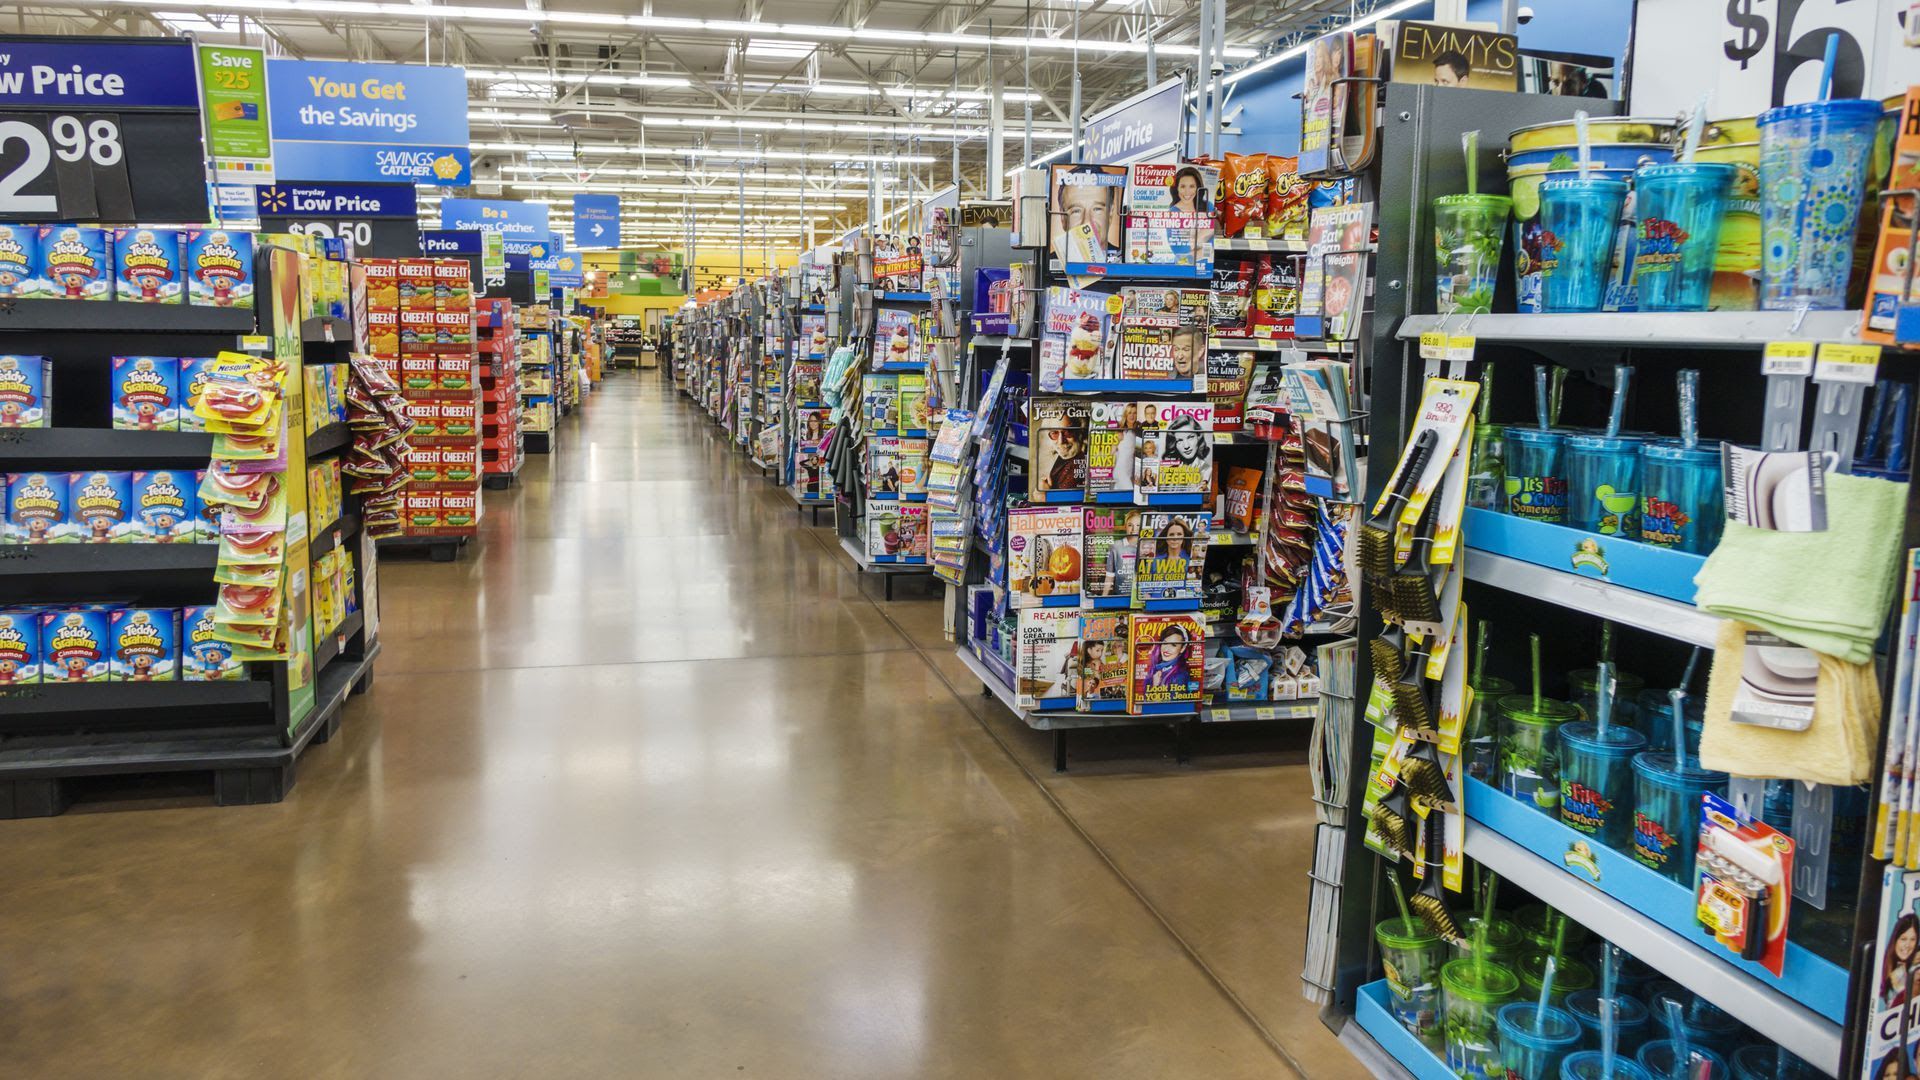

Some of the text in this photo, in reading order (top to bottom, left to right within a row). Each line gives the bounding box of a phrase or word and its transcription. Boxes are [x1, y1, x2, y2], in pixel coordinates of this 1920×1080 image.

[1402, 26, 1515, 69] EMMYS
[211, 52, 253, 69] Save
[31, 64, 125, 96] Price
[308, 76, 406, 101] You Get
[299, 105, 418, 132] the Savings
[1100, 120, 1153, 160] Low Price
[376, 151, 436, 167] SAVINGS
[380, 165, 432, 177] CATCHER
[1135, 165, 1177, 177] Woman's
[1055, 168, 1124, 189] People TRIBUTE
[1135, 176, 1164, 186] World
[292, 188, 326, 198] Everyday
[293, 196, 381, 211] Low Price
[483, 207, 508, 218] Be a
[1311, 209, 1364, 229] Prevention
[456, 220, 535, 233] Savings Catcher.
[1321, 231, 1338, 242] Eat
[53, 241, 90, 256] Teddy
[129, 243, 164, 258] Teddy
[202, 244, 238, 259] Teddy
[428, 240, 459, 251] Price
[48, 251, 96, 267] Grahams
[124, 254, 169, 269] Grahams
[197, 255, 243, 270] Grahams
[1328, 255, 1354, 268] Weight
[399, 264, 432, 277] CHEEZ-IT
[434, 266, 468, 278] CHEEZ-IT
[401, 312, 434, 324] CHEEZ-IT
[436, 313, 469, 325] CHEEZ-IT
[1049, 307, 1077, 322] Save
[1124, 317, 1178, 326] GLOBE
[1123, 345, 1172, 357] AUTOPSY
[402, 359, 436, 371] CHEEZ-IT
[438, 359, 471, 371] CHEEZ-IT
[1123, 358, 1174, 371] SHOCKER!
[1220, 367, 1245, 376] LINK'S
[128, 369, 163, 384] Teddy
[122, 380, 168, 395] Grahams
[406, 405, 440, 417] CHEEZ-IT
[441, 405, 475, 417] CHEEZ-IT
[1033, 406, 1066, 421] Jerry
[1161, 407, 1212, 422] closer
[407, 451, 440, 463] CHEEZ-IT
[442, 451, 474, 463] CHEEZ-IT
[1159, 473, 1201, 485] LEGEND
[1523, 476, 1543, 493] It's
[20, 487, 54, 502] Teddy
[83, 486, 118, 500] Teddy
[146, 485, 180, 499] Teddy
[14, 497, 59, 511] Grahams
[77, 496, 122, 510] Grahams
[140, 494, 185, 508] Grahams
[407, 496, 440, 508] CHEEZ-IT
[442, 496, 475, 508] CHEEZ-IT
[1008, 514, 1082, 532] Halloween
[1086, 510, 1115, 529] Good
[1142, 514, 1168, 529] Life
[1139, 559, 1186, 574] AT WAR
[1034, 612, 1057, 620] REAL
[57, 626, 92, 640] Teddy
[124, 624, 157, 638] Teddy
[52, 635, 98, 650] Grahams
[119, 633, 163, 648] Grahams
[1146, 683, 1186, 693] Look Hot
[1145, 692, 1172, 701] YOUR
[1714, 886, 1741, 907] BIC
